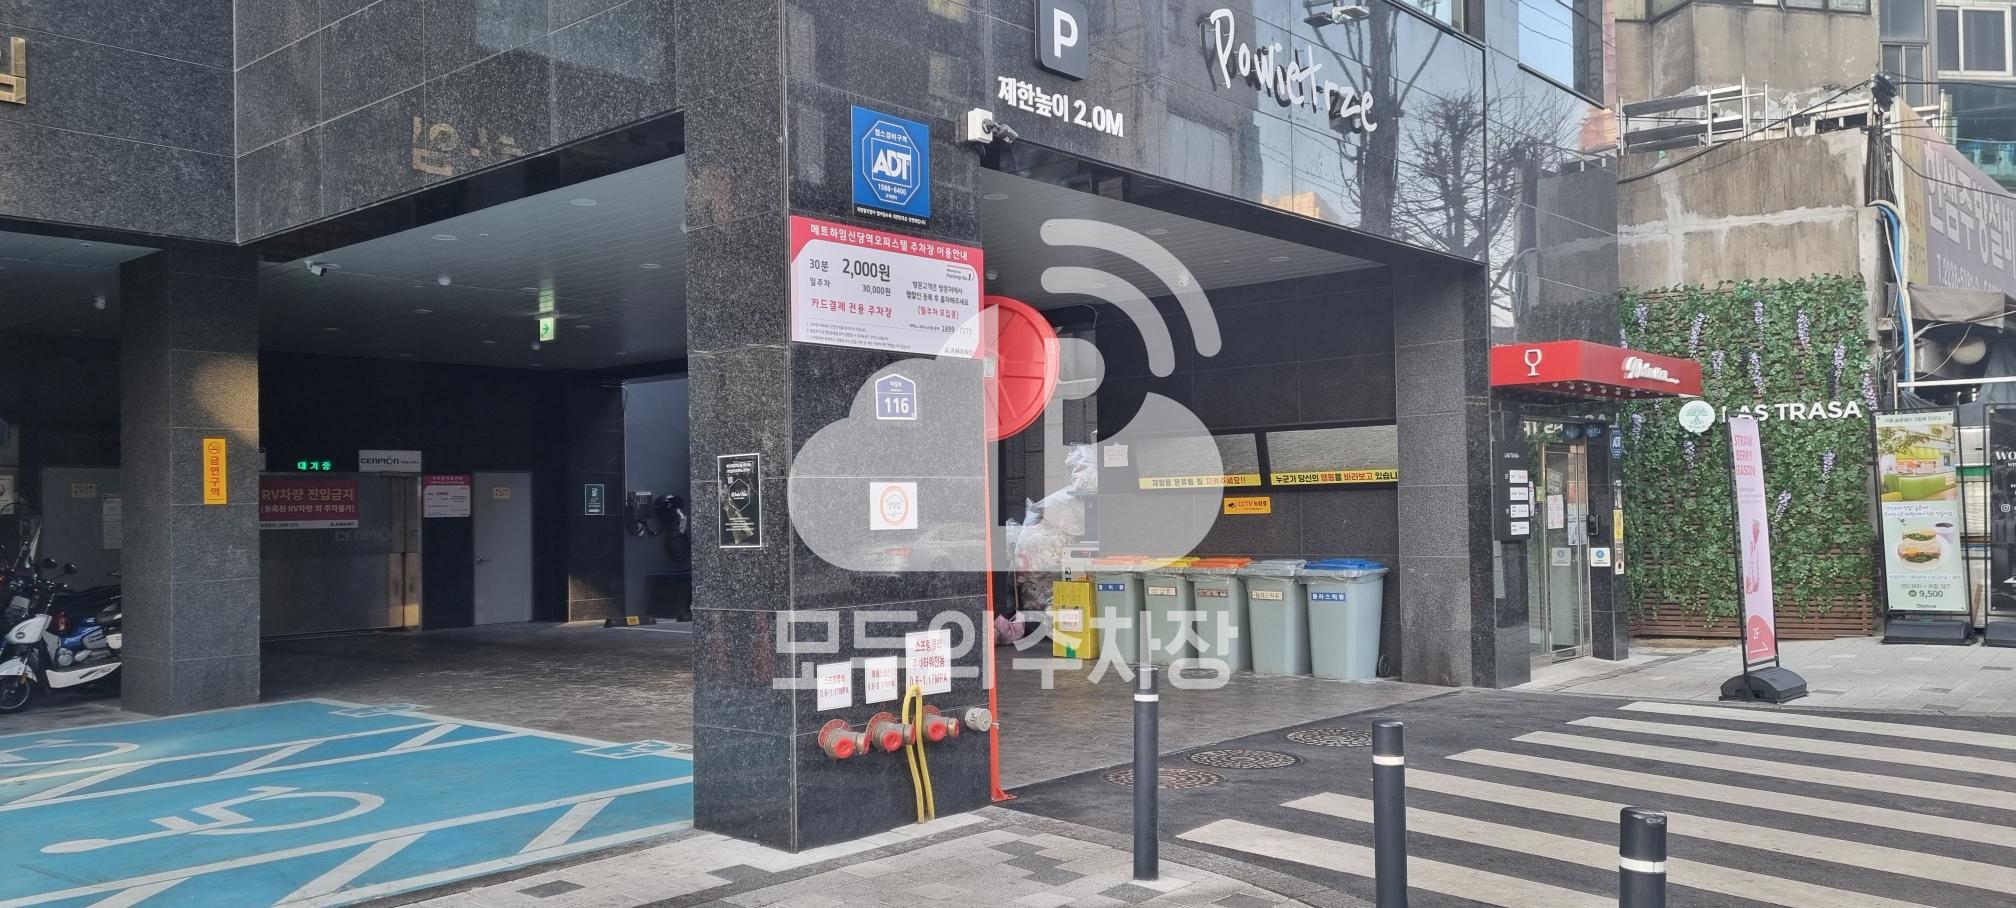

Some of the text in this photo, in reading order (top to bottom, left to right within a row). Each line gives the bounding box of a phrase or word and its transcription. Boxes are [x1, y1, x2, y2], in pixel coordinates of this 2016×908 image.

[1053, 7, 1079, 58] P
[1210, 8, 1378, 132] Powietrze
[997, 75, 1124, 138] 제한높이 2.0M
[872, 148, 912, 180] ADT
[878, 183, 907, 196] 1588-6400
[810, 223, 968, 261] 메트하임신당역오피스텔 주차장 이용안내
[809, 258, 891, 283] 30분 2,000원
[809, 276, 892, 297] 일주차 30,000원
[912, 280, 938, 292] 방문고객은
[923, 292, 933, 302] 등록
[811, 298, 892, 318] 카드결제 전용 주차장
[939, 308, 960, 320] 모집중)
[884, 396, 909, 413] 116
[1774, 400, 1863, 421] TRASA
[1734, 435, 1754, 448] STRAW
[1735, 450, 1753, 462] BERRY
[297, 460, 332, 471] 대기중
[209, 455, 221, 497] 금연구역
[1275, 474, 1297, 484] 누군가
[1298, 474, 1319, 483] 당신의
[1343, 472, 1373, 481] 바라보고
[261, 487, 354, 502] RV차량 진입금지
[288, 504, 313, 513] RV차량
[1312, 592, 1345, 601] 플라스틱류
[1919, 590, 1944, 598] 9,500
